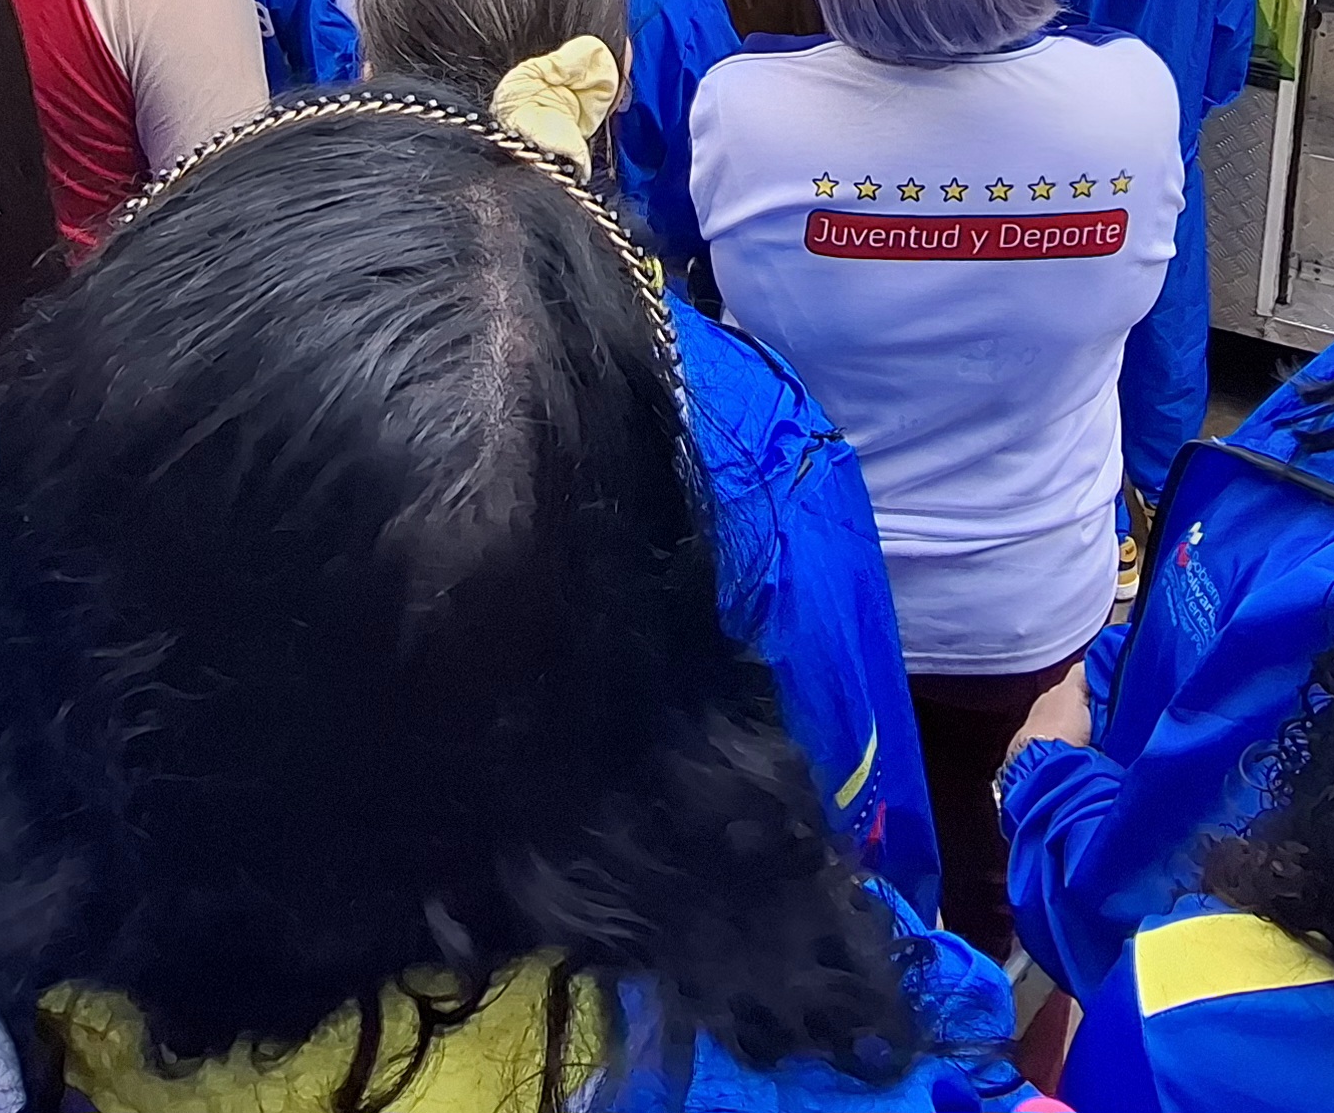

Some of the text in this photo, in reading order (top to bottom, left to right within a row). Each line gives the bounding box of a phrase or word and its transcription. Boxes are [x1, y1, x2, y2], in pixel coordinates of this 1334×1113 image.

[813, 218, 1121, 254] Juventud y Deporte
